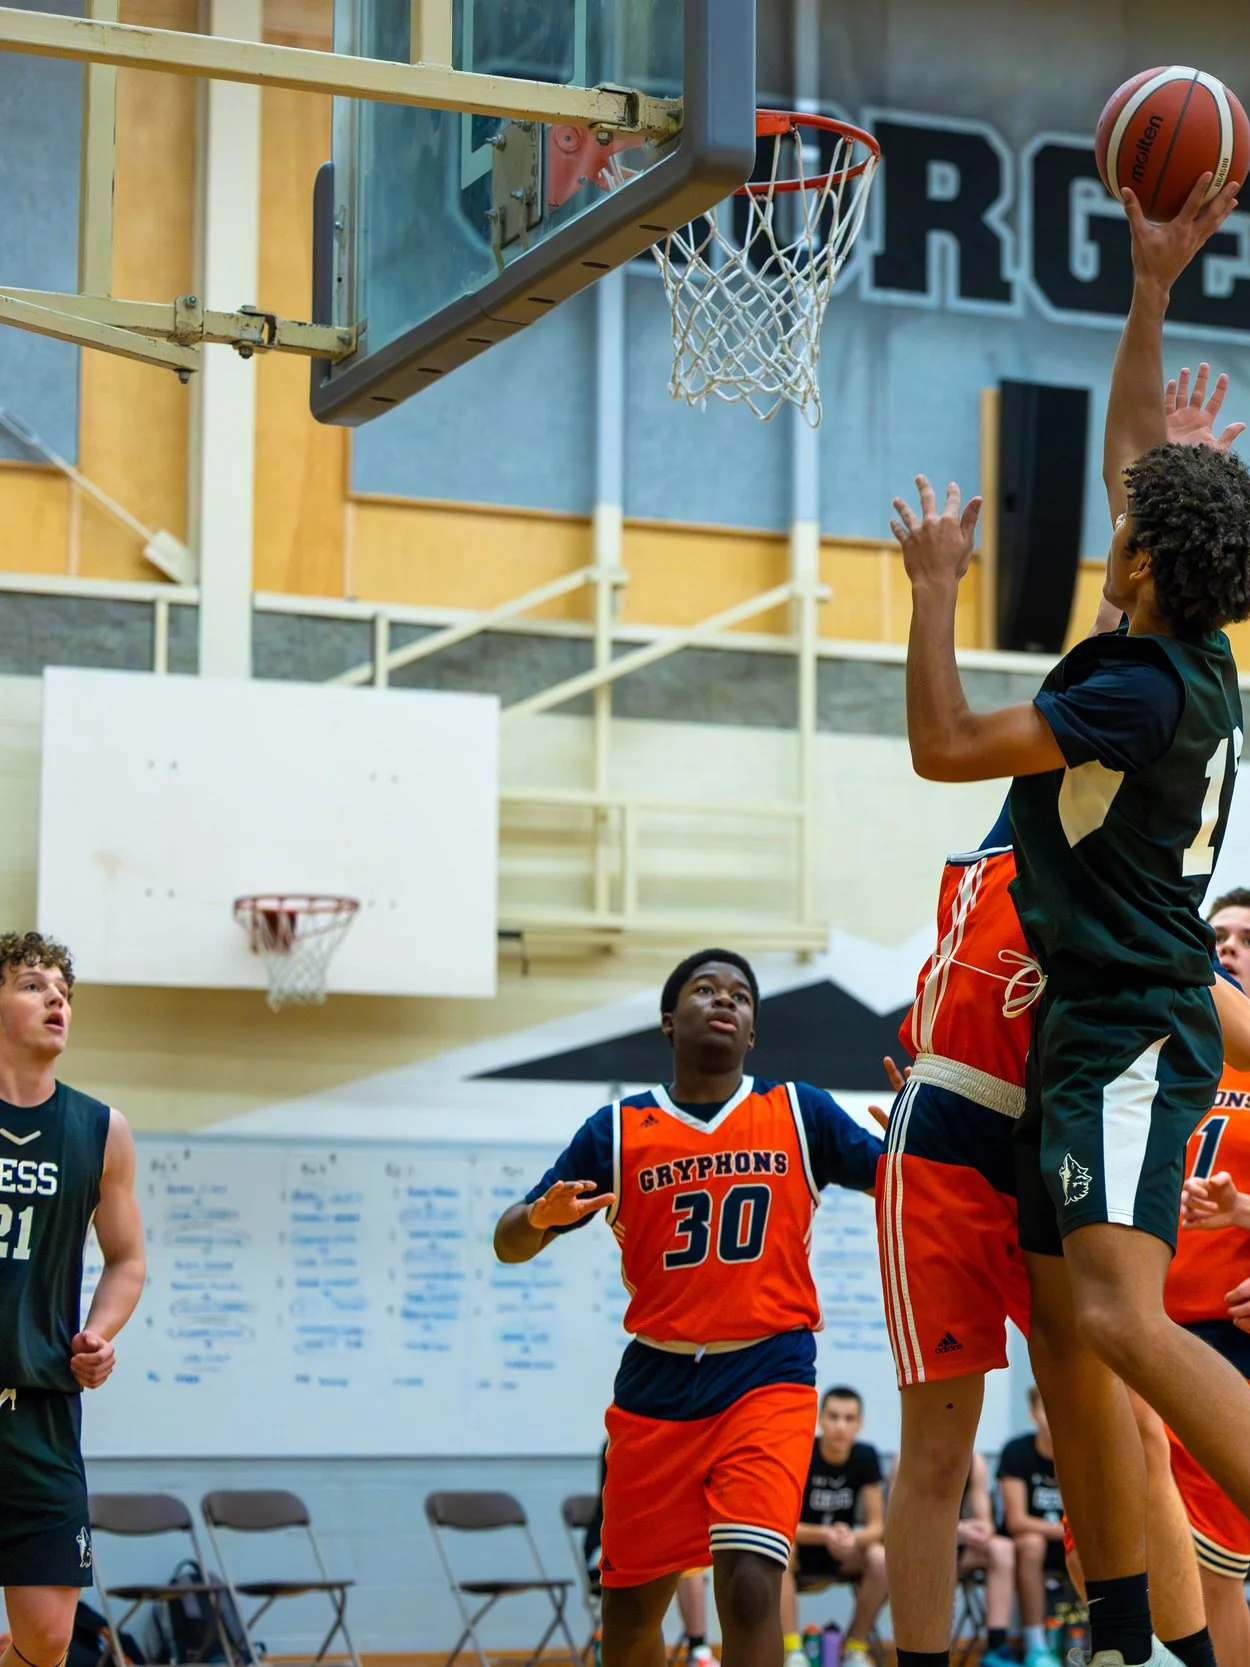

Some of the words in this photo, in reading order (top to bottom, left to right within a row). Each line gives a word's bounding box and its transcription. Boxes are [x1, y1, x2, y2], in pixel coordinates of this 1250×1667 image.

[1131, 115, 1164, 183] molten
[0, 1158, 58, 1196] ESS
[638, 1151, 788, 1193] GRYPHONS
[1190, 1115, 1230, 1180] 1
[663, 1183, 772, 1271] 30
